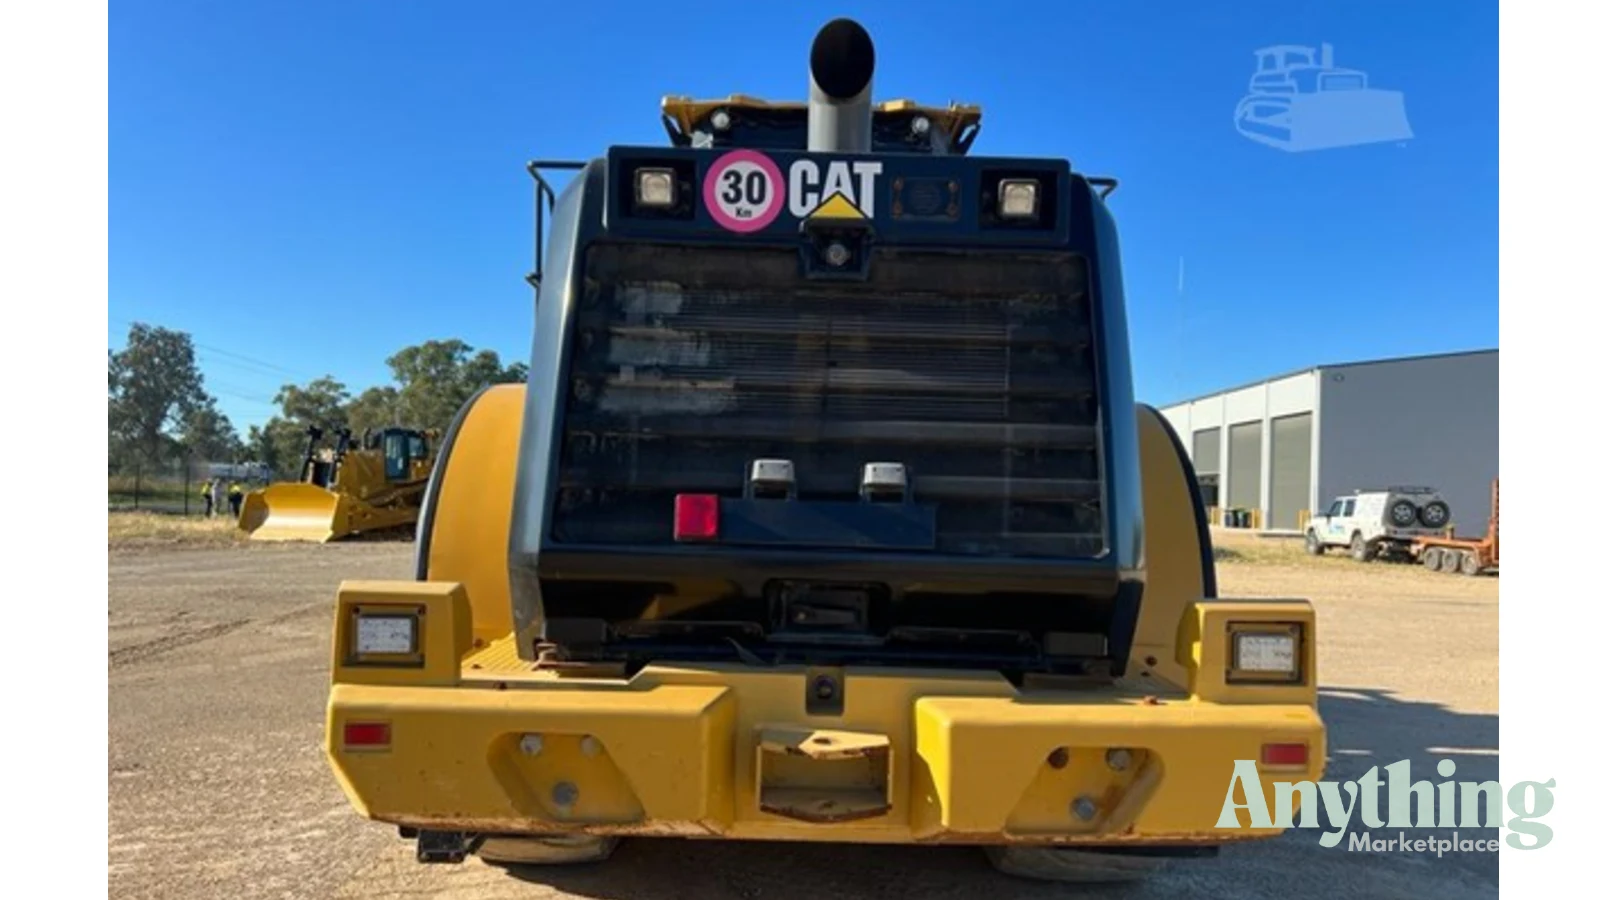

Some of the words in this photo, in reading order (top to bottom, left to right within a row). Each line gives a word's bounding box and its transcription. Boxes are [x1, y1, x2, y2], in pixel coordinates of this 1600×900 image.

[722, 170, 766, 206] 30
[789, 160, 882, 219] CAT
[735, 208, 752, 218] Km
